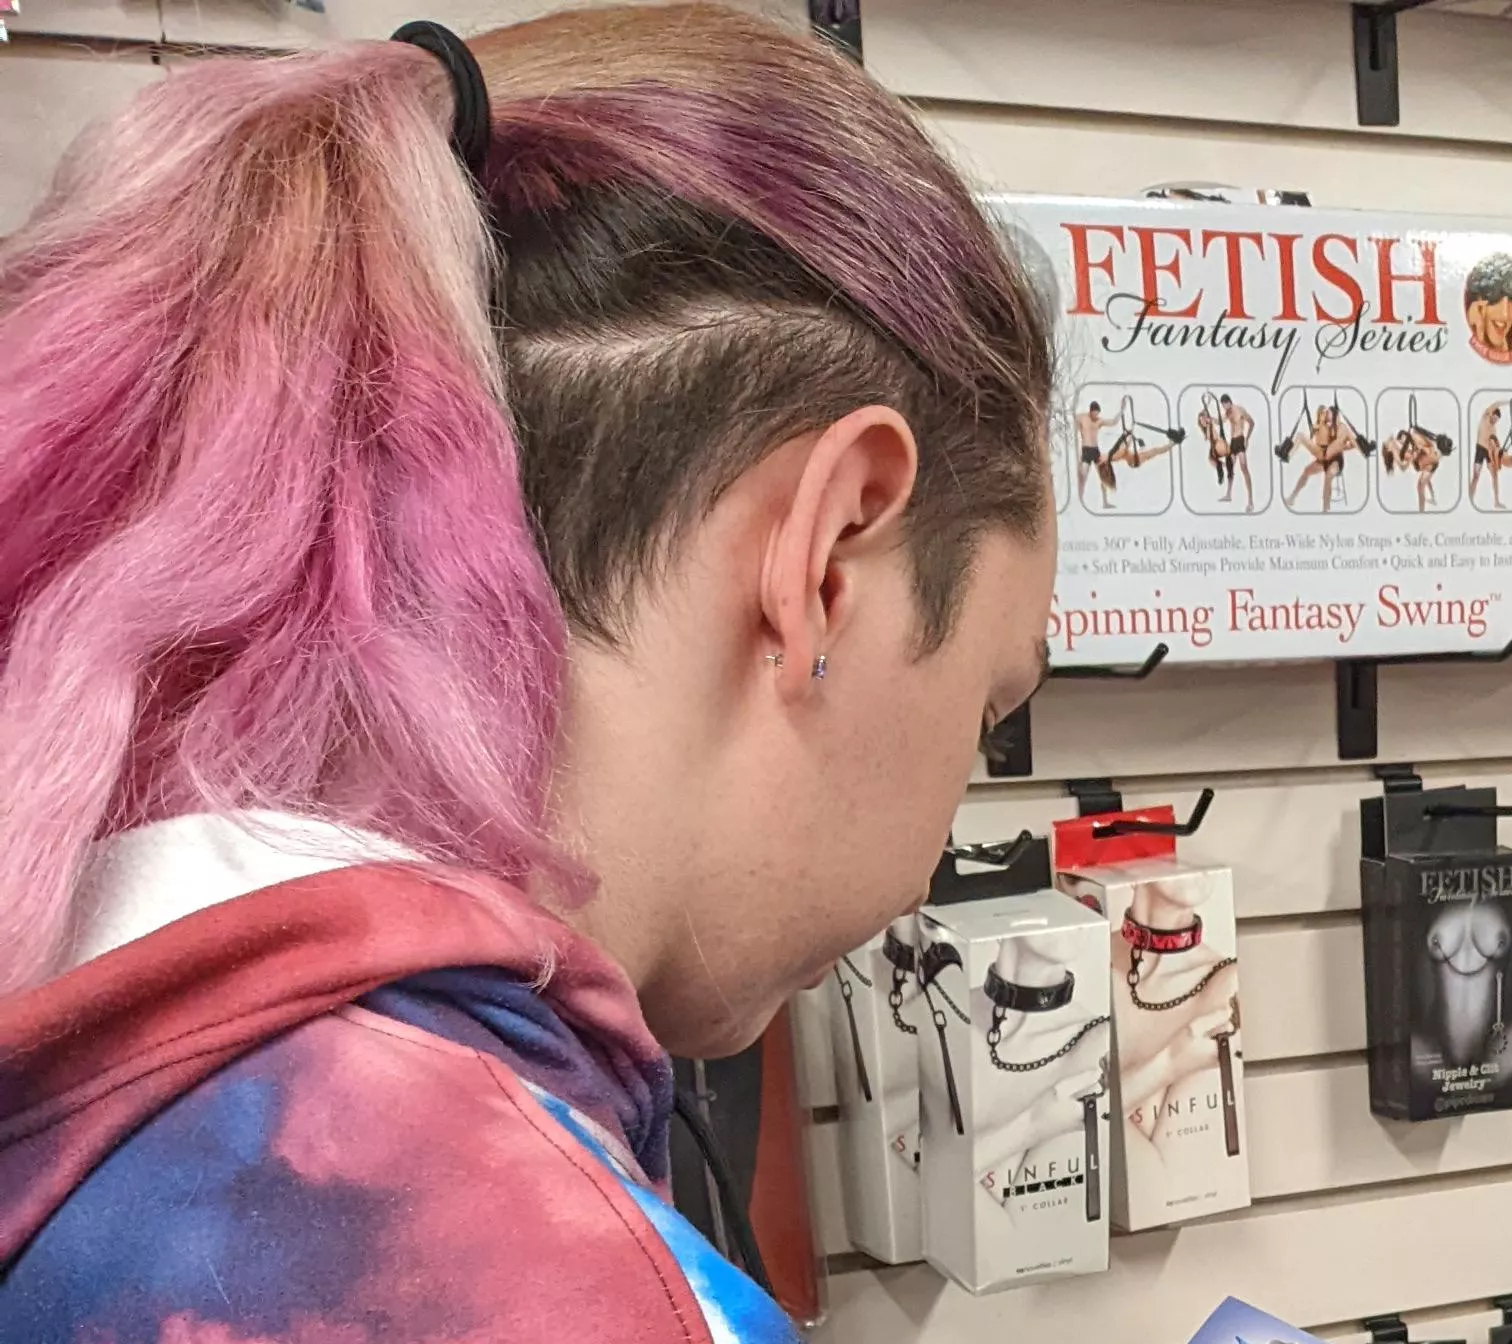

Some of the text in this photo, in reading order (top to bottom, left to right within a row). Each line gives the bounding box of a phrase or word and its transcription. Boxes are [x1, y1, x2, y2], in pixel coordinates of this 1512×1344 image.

[1060, 223, 1446, 325] FETISH
[1101, 293, 1448, 396] Fantasy Series
[1144, 536, 1173, 553] Fully
[1249, 535, 1316, 550] Extra-Wide
[1319, 534, 1354, 550] Nylon
[1358, 534, 1392, 551] Straps
[1404, 533, 1432, 548] Safe,
[1435, 532, 1507, 547] Comfortable,
[1092, 560, 1118, 574] Soft
[1121, 559, 1166, 574] Padded
[1170, 558, 1216, 577] Stirrups
[1220, 557, 1265, 572] Provide
[1270, 556, 1328, 572] Maximum
[1332, 555, 1378, 570] Comfort
[1390, 554, 1424, 571] Quick
[1427, 554, 1447, 568] and
[1450, 554, 1474, 571] Easy
[1047, 589, 1367, 651] Spinning Fantasy
[1135, 1090, 1235, 1124] SINFUL
[984, 1153, 1098, 1189] SINFUL
